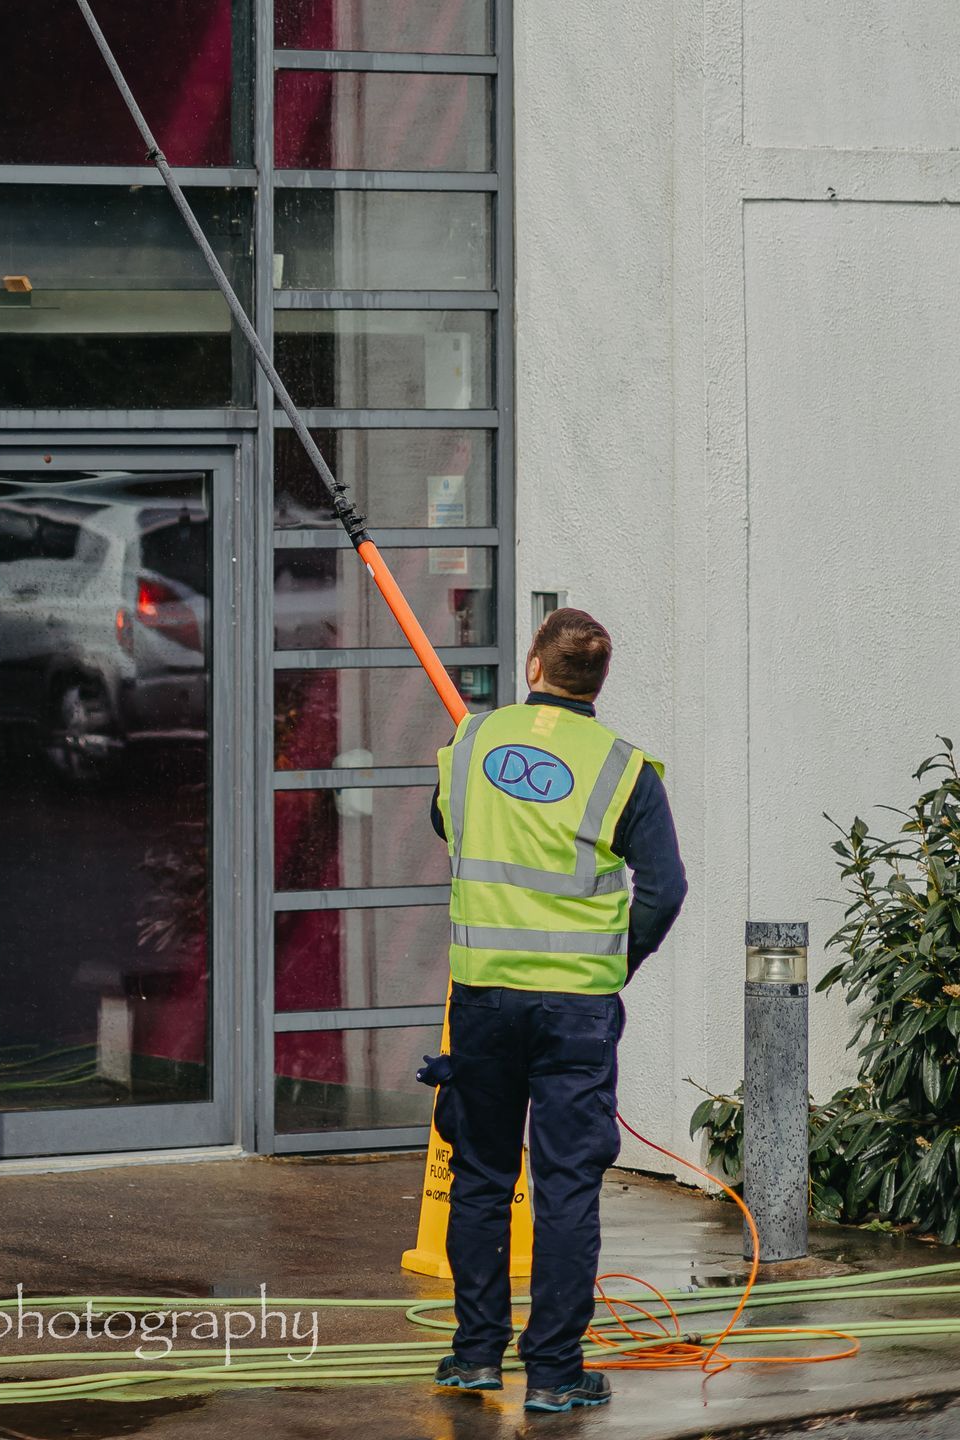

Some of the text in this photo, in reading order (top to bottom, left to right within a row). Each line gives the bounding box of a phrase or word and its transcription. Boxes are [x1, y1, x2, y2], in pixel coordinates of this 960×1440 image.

[497, 749, 558, 796] DG
[435, 1148, 450, 1163] WET
[430, 1164, 451, 1182] FLOOR
